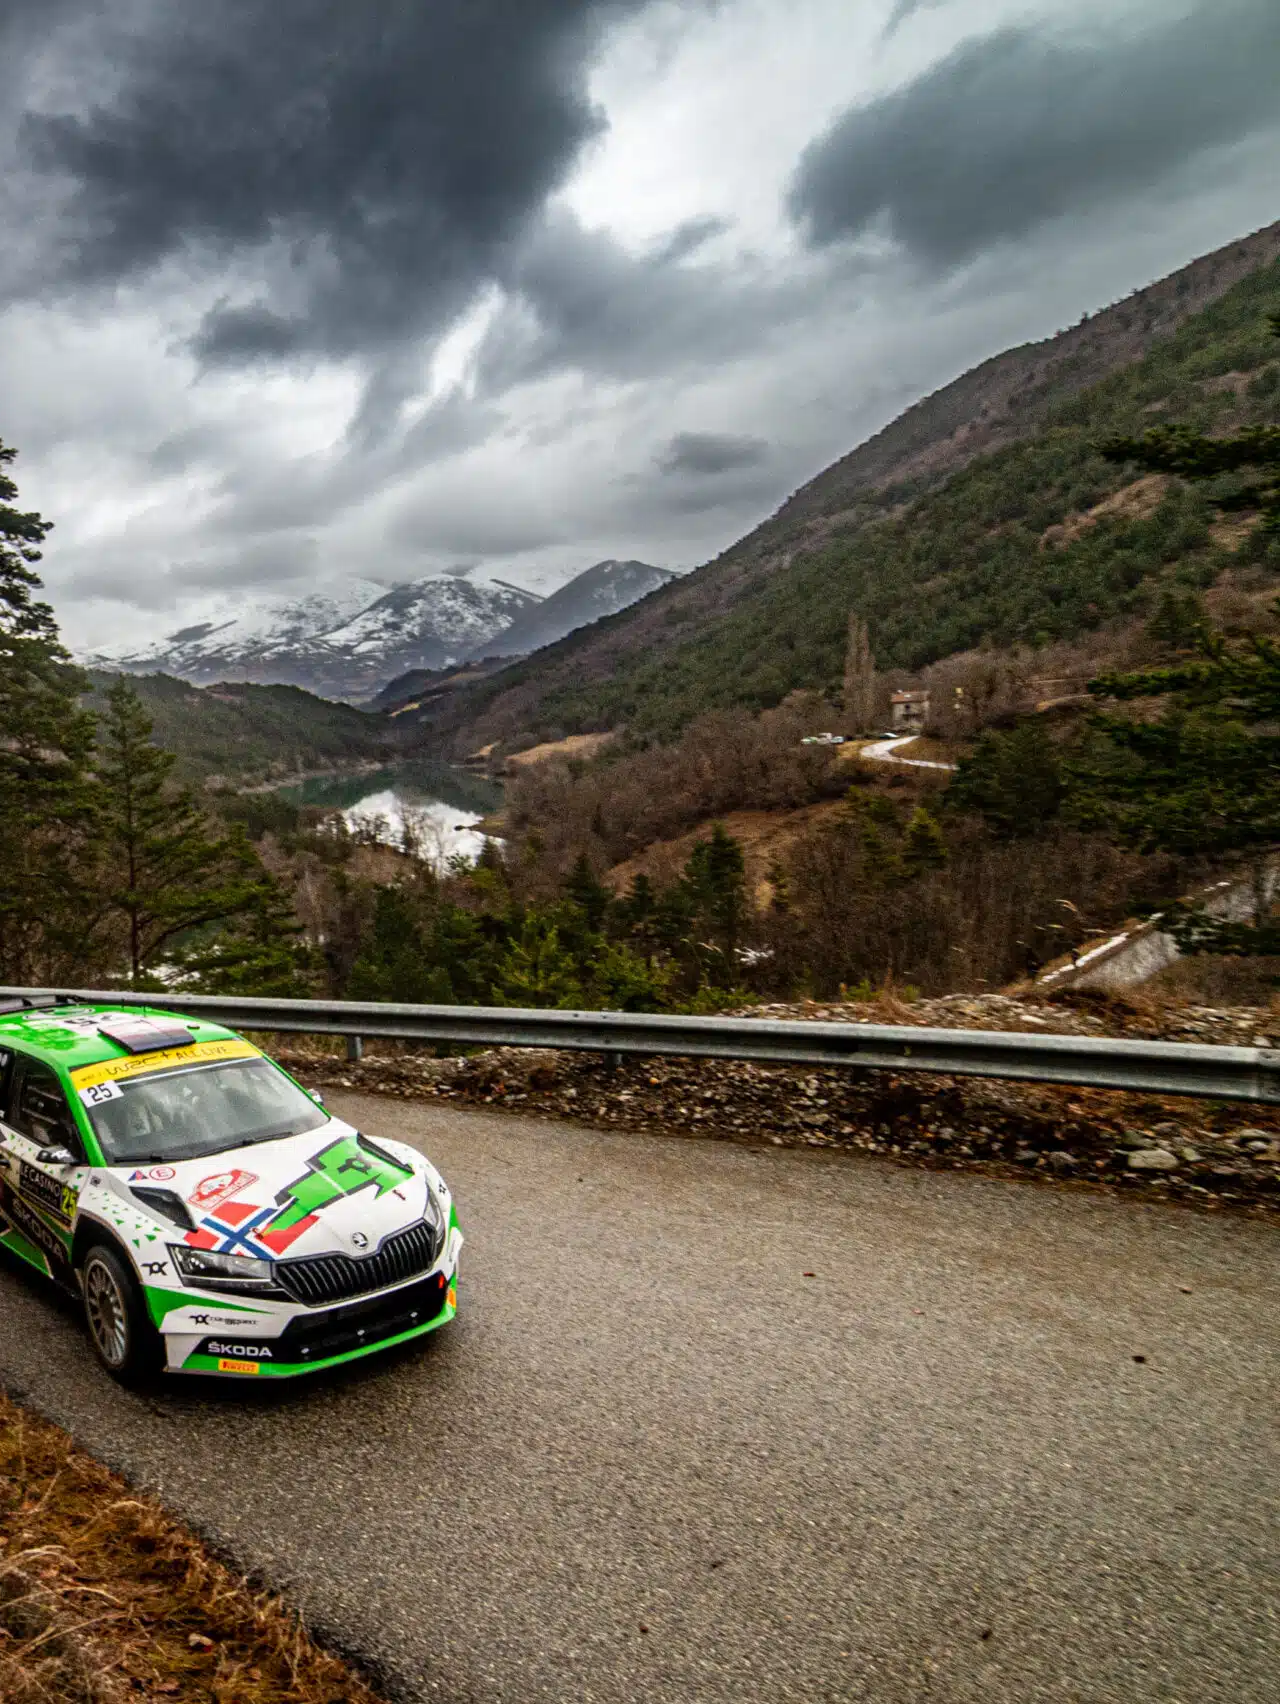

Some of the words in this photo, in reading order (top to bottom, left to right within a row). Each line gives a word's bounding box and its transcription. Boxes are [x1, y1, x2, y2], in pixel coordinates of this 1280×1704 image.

[87, 1083, 112, 1102] 25
[62, 1185, 77, 1217] 25
[208, 1341, 272, 1357] ŠKODA
